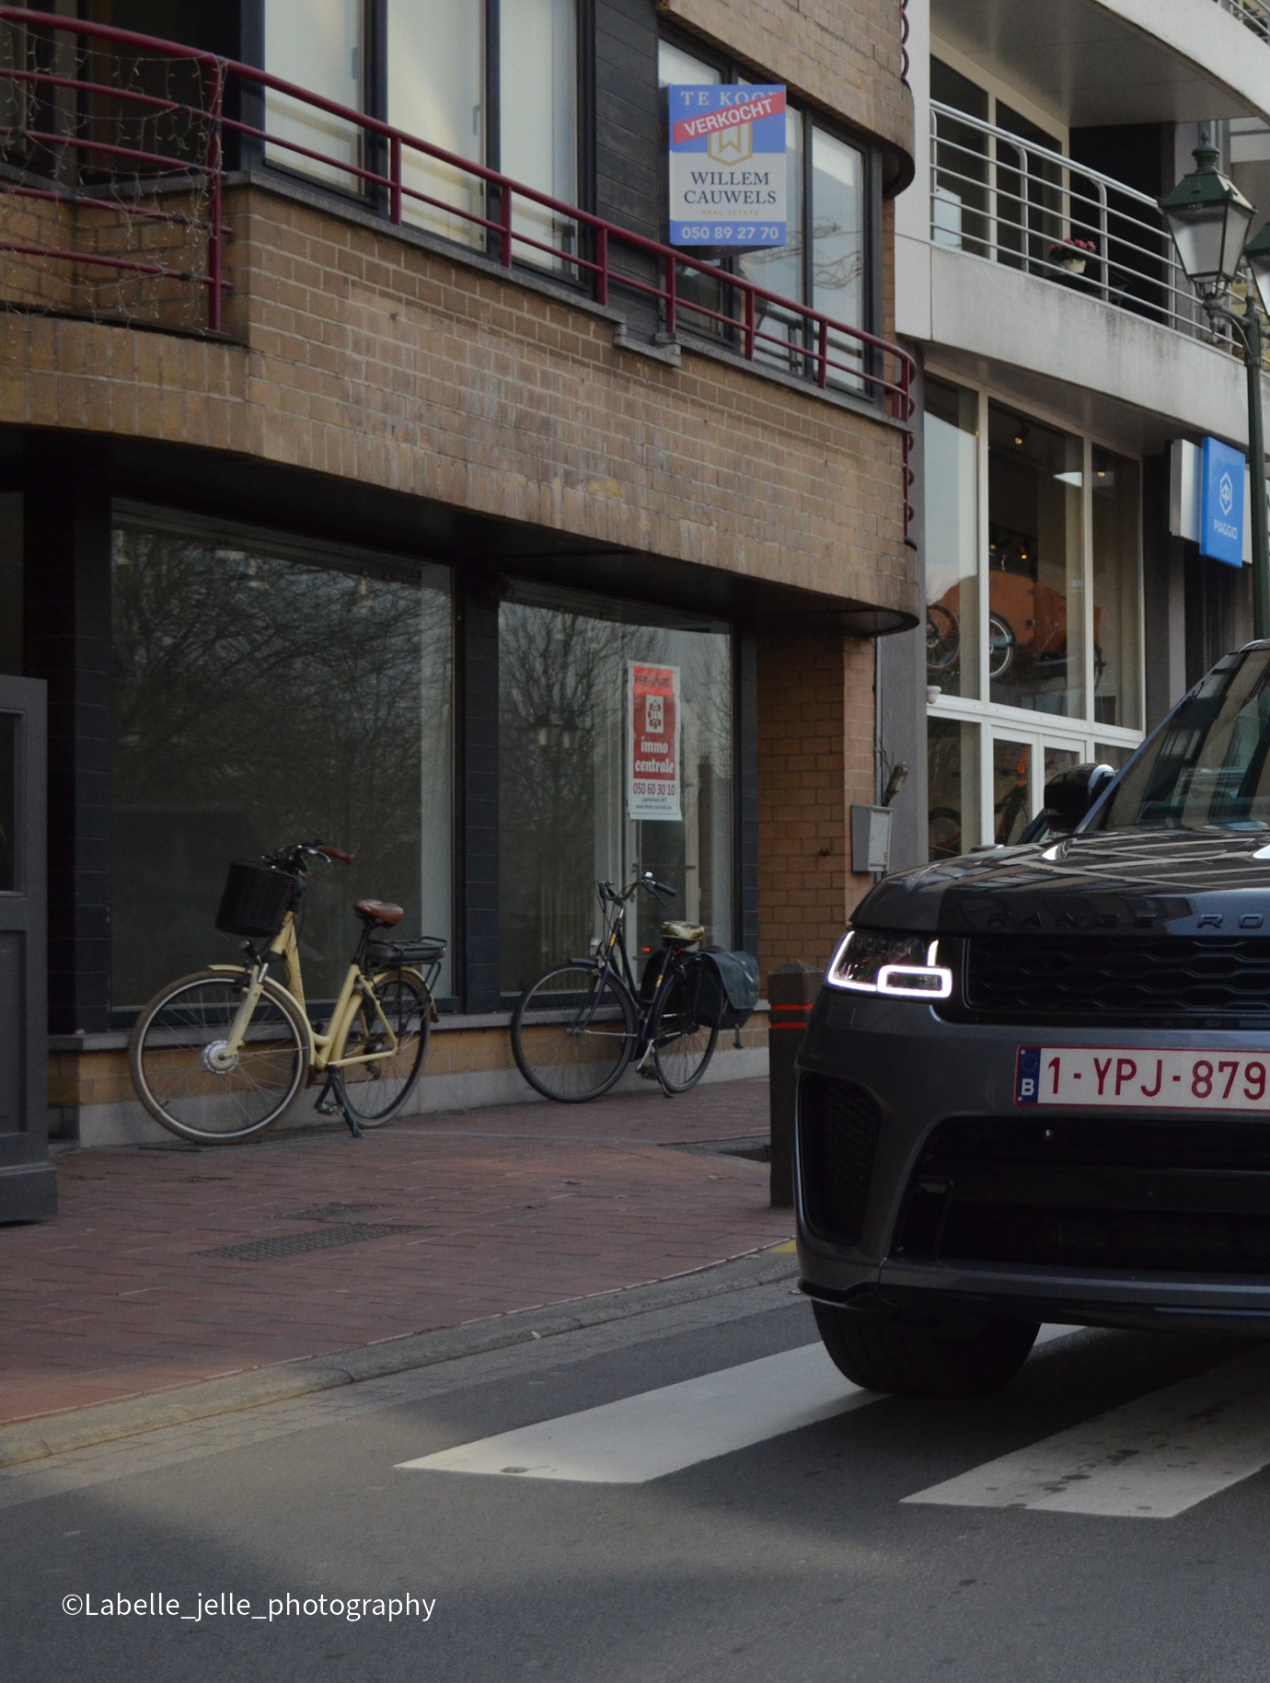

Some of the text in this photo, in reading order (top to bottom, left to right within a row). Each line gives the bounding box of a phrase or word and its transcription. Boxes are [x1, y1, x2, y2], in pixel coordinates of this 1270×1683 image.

[681, 91, 776, 105] TE KOO
[684, 99, 772, 136] VERKOCHT
[690, 171, 770, 185] WILLEM
[684, 190, 777, 204] CAUWELS
[682, 227, 779, 239] 050 89 27 70
[1214, 519, 1238, 540] PIAGGIO
[641, 737, 669, 754] immo
[635, 759, 675, 773] centrale
[633, 782, 675, 795] 050 60 30 10
[987, 912, 1157, 928] RANGE
[1021, 1056, 1267, 1100] B 1-YPJ-879
